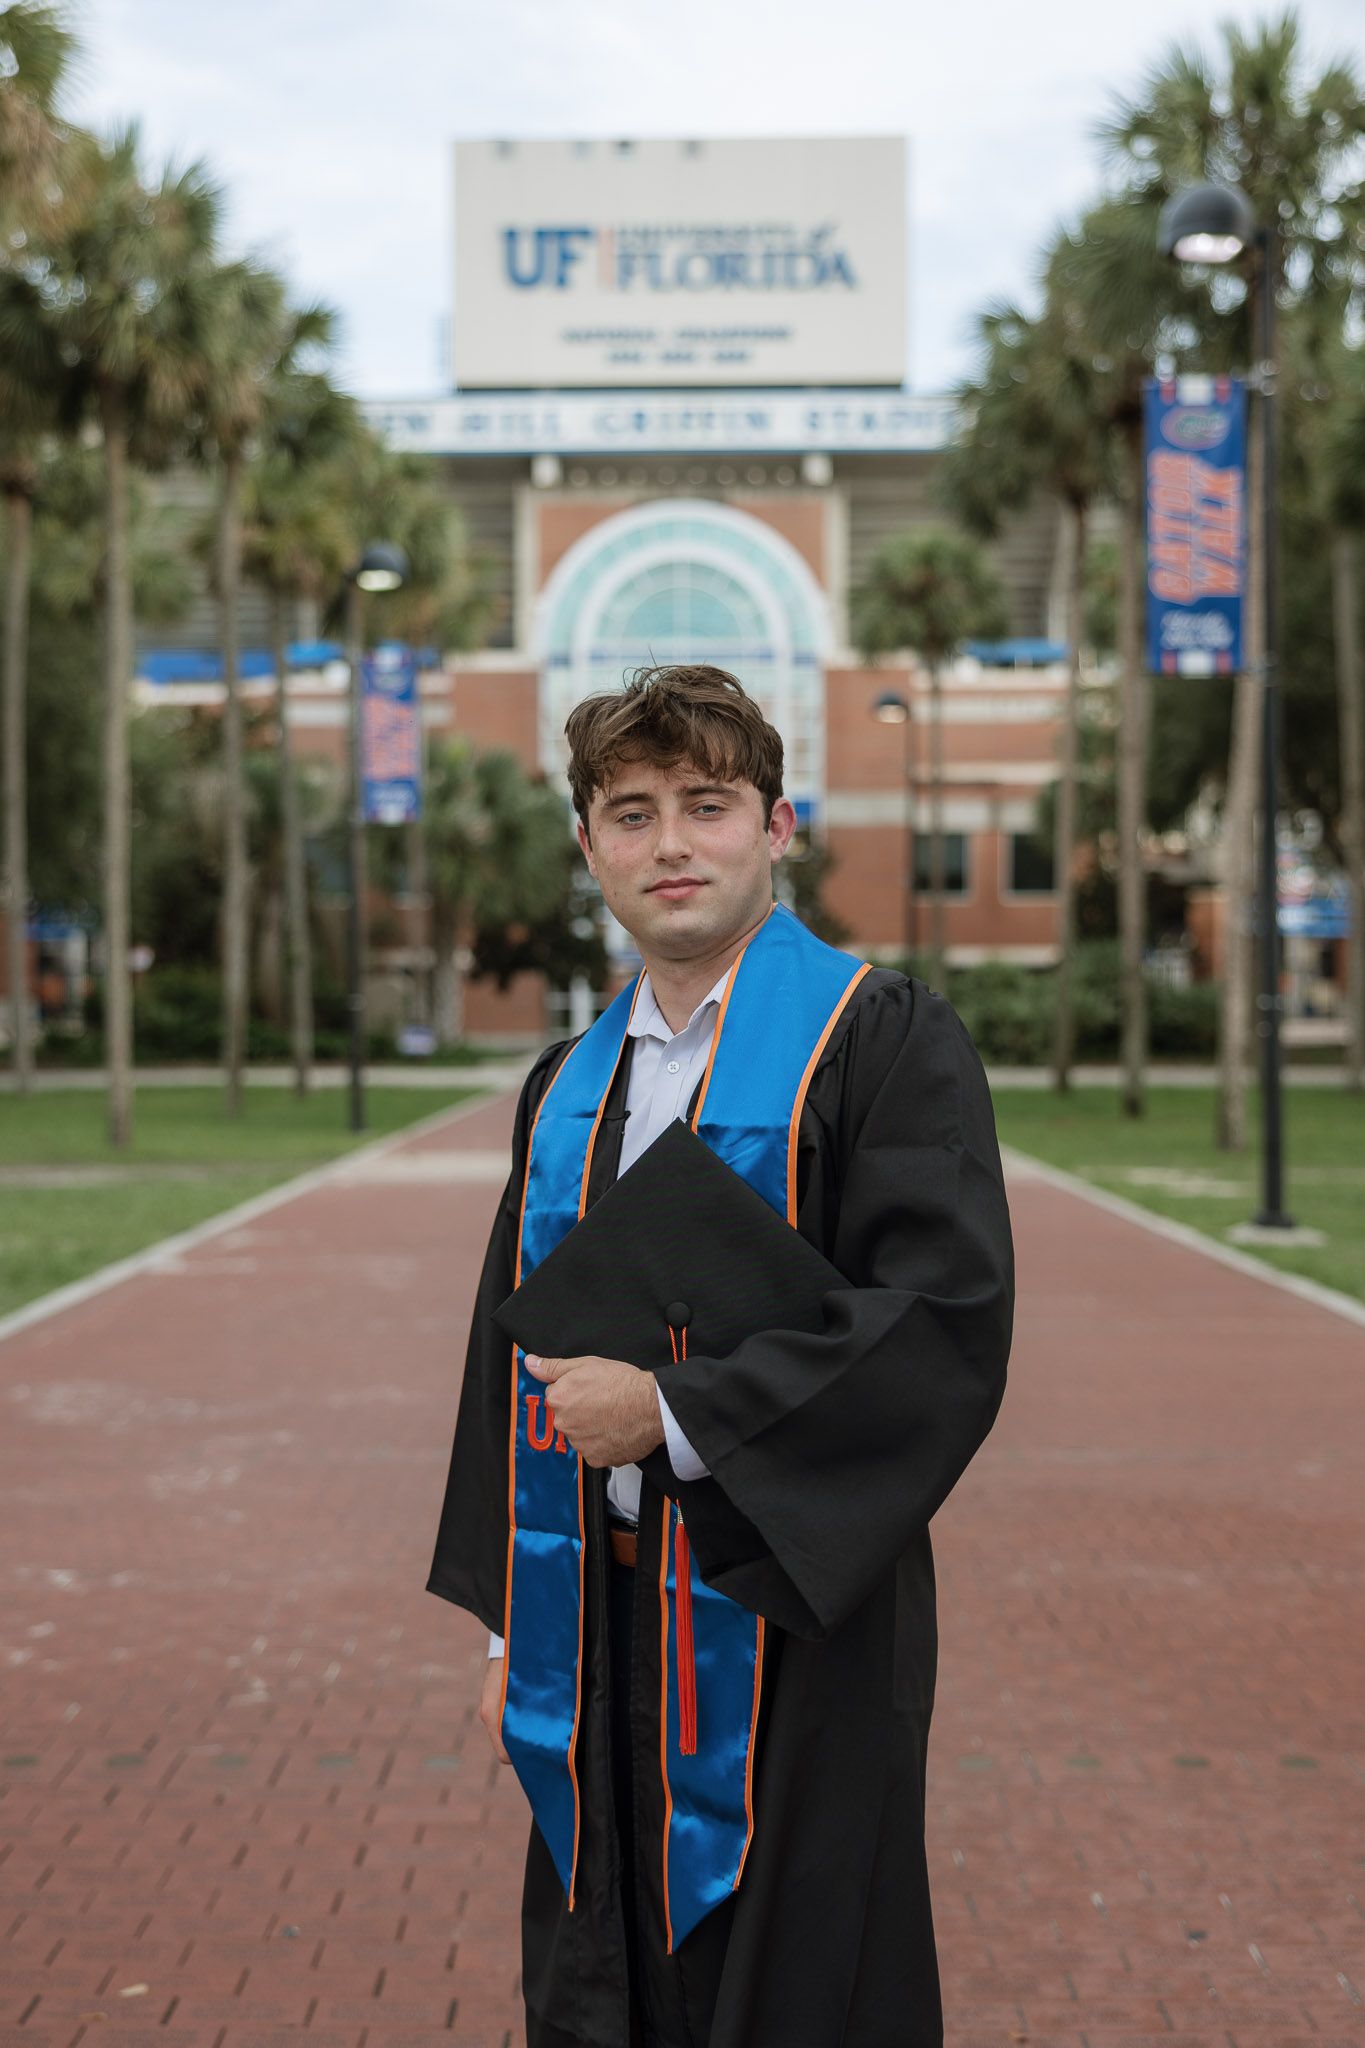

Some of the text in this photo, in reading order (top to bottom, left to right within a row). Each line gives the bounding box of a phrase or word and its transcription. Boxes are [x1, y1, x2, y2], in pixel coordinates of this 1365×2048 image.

[503, 226, 592, 290] UF
[617, 250, 858, 291] FLORIDA
[1192, 467, 1240, 597] WALK
[525, 1394, 567, 1454] U
